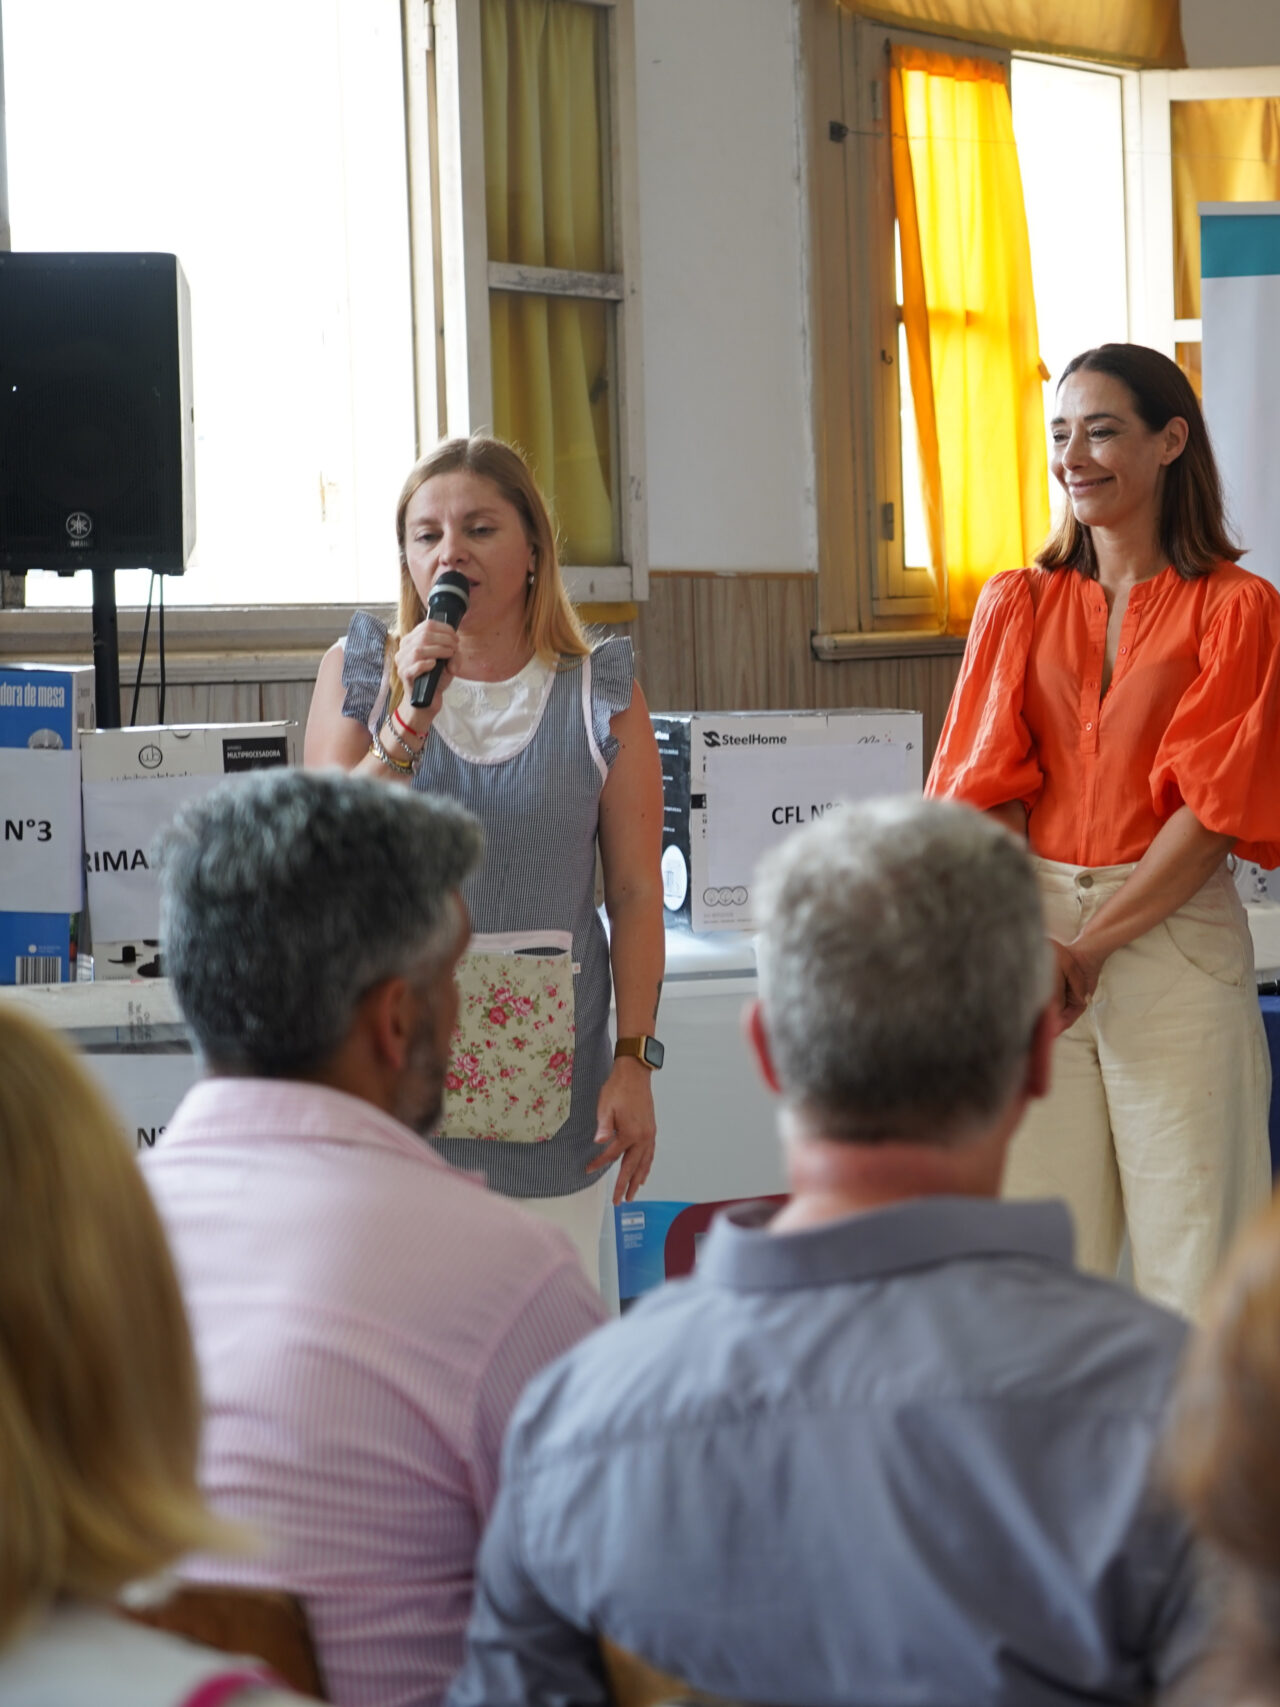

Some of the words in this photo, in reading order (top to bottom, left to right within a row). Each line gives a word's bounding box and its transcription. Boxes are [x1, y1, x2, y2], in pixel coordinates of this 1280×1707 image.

[24, 682, 37, 707] de
[38, 686, 65, 708] mesa
[722, 733, 787, 746] SteelHome
[227, 749, 281, 760] MULTIPROCESADORA
[771, 805, 805, 825] CFL
[811, 802, 843, 821] N°
[5, 819, 53, 842] N°3
